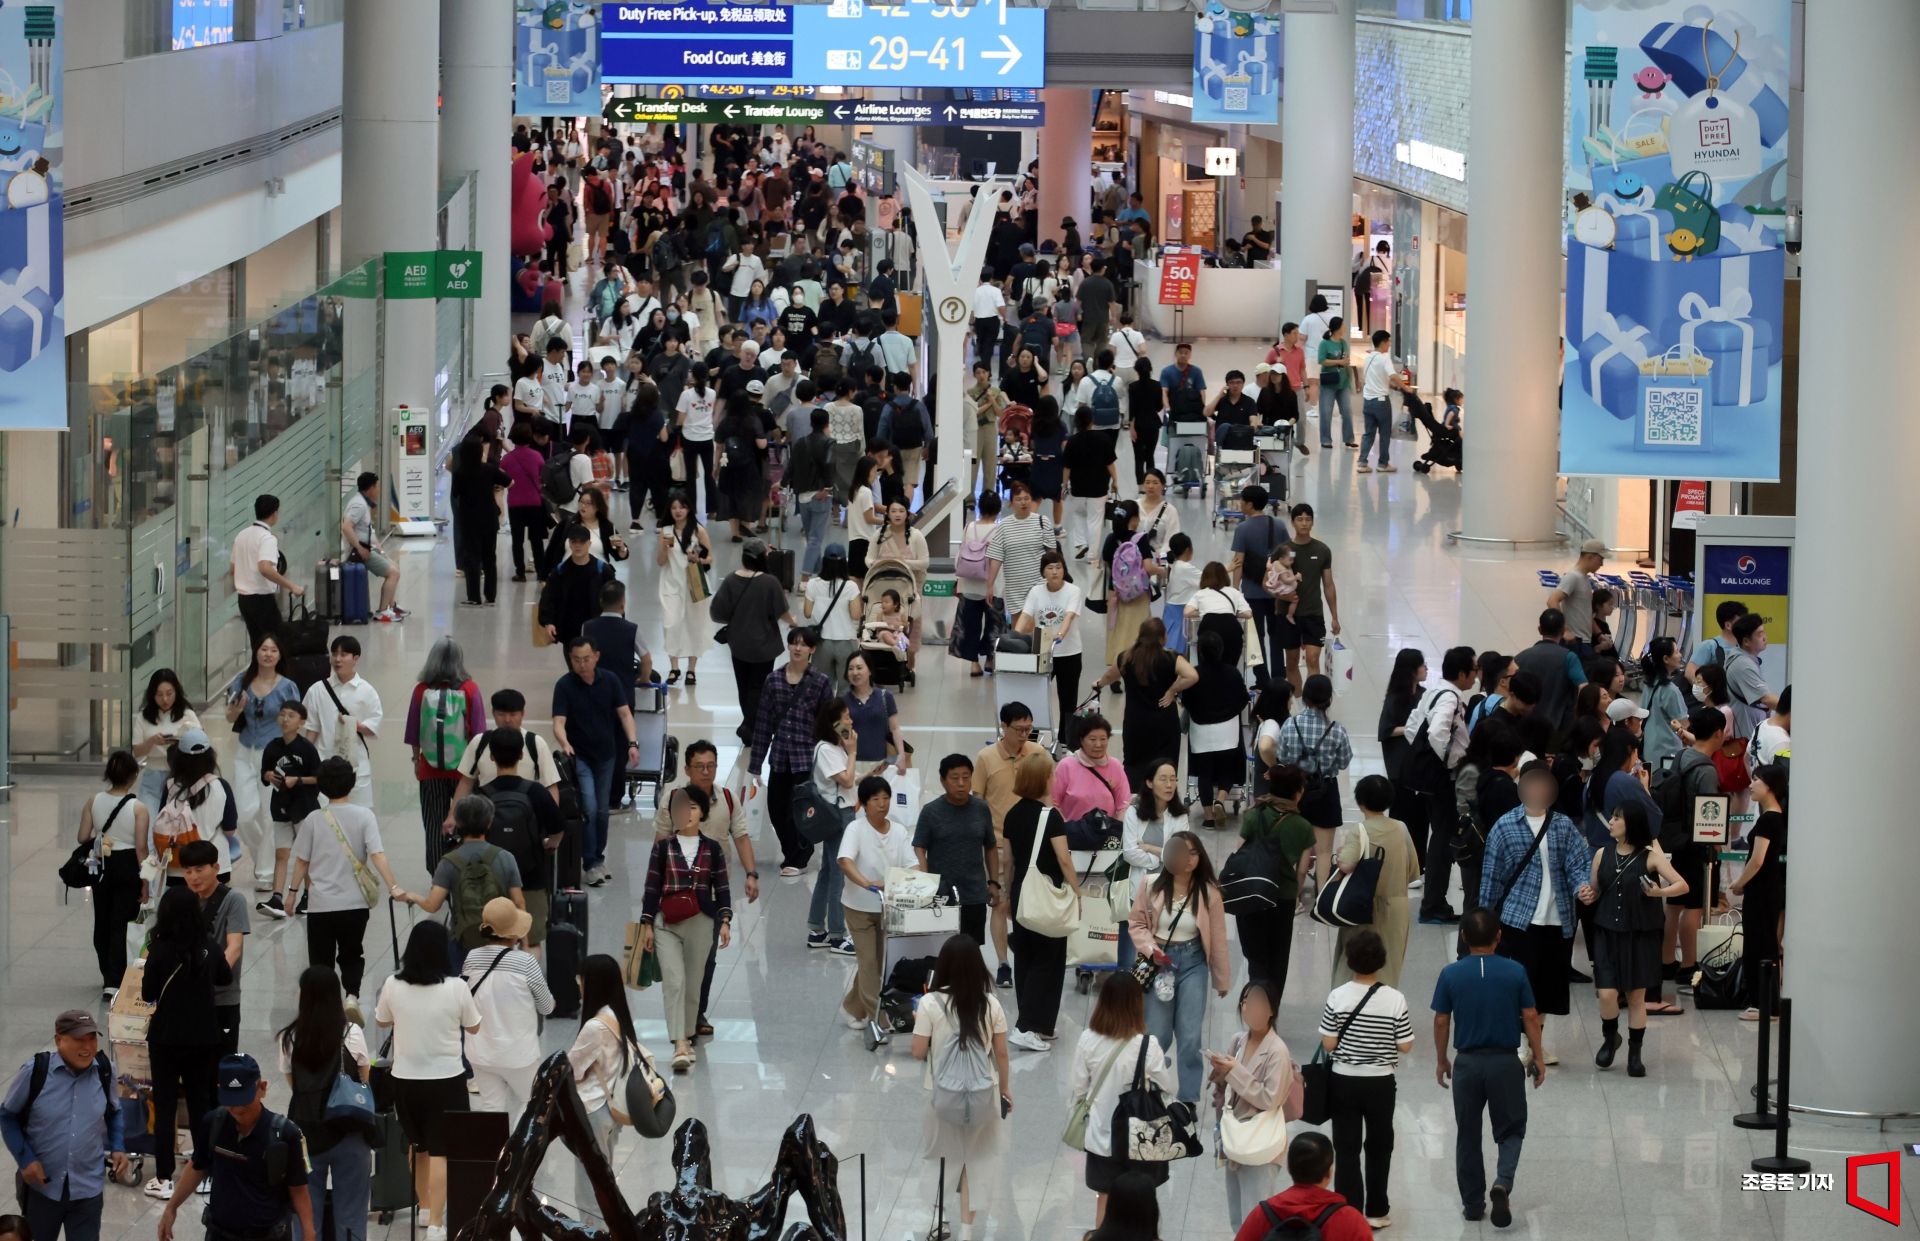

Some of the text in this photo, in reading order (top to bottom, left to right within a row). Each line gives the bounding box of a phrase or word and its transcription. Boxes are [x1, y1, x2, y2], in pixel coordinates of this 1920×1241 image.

[619, 7, 786, 23] Duty Free Pick-up, 免税品领取处
[683, 51, 786, 66] Food Court, 美食街
[868, 35, 965, 71] 29-41
[635, 102, 708, 113] Transfer Desk
[744, 105, 824, 119] Transfer Lounge
[854, 103, 932, 117] Airline Lounges
[1636, 138, 1655, 148] SALE
[1694, 148, 1740, 159] HYUNDAI
[404, 265, 427, 276] AED
[447, 281, 469, 289] AED
[1721, 577, 1772, 585] KAL LOUNGE
